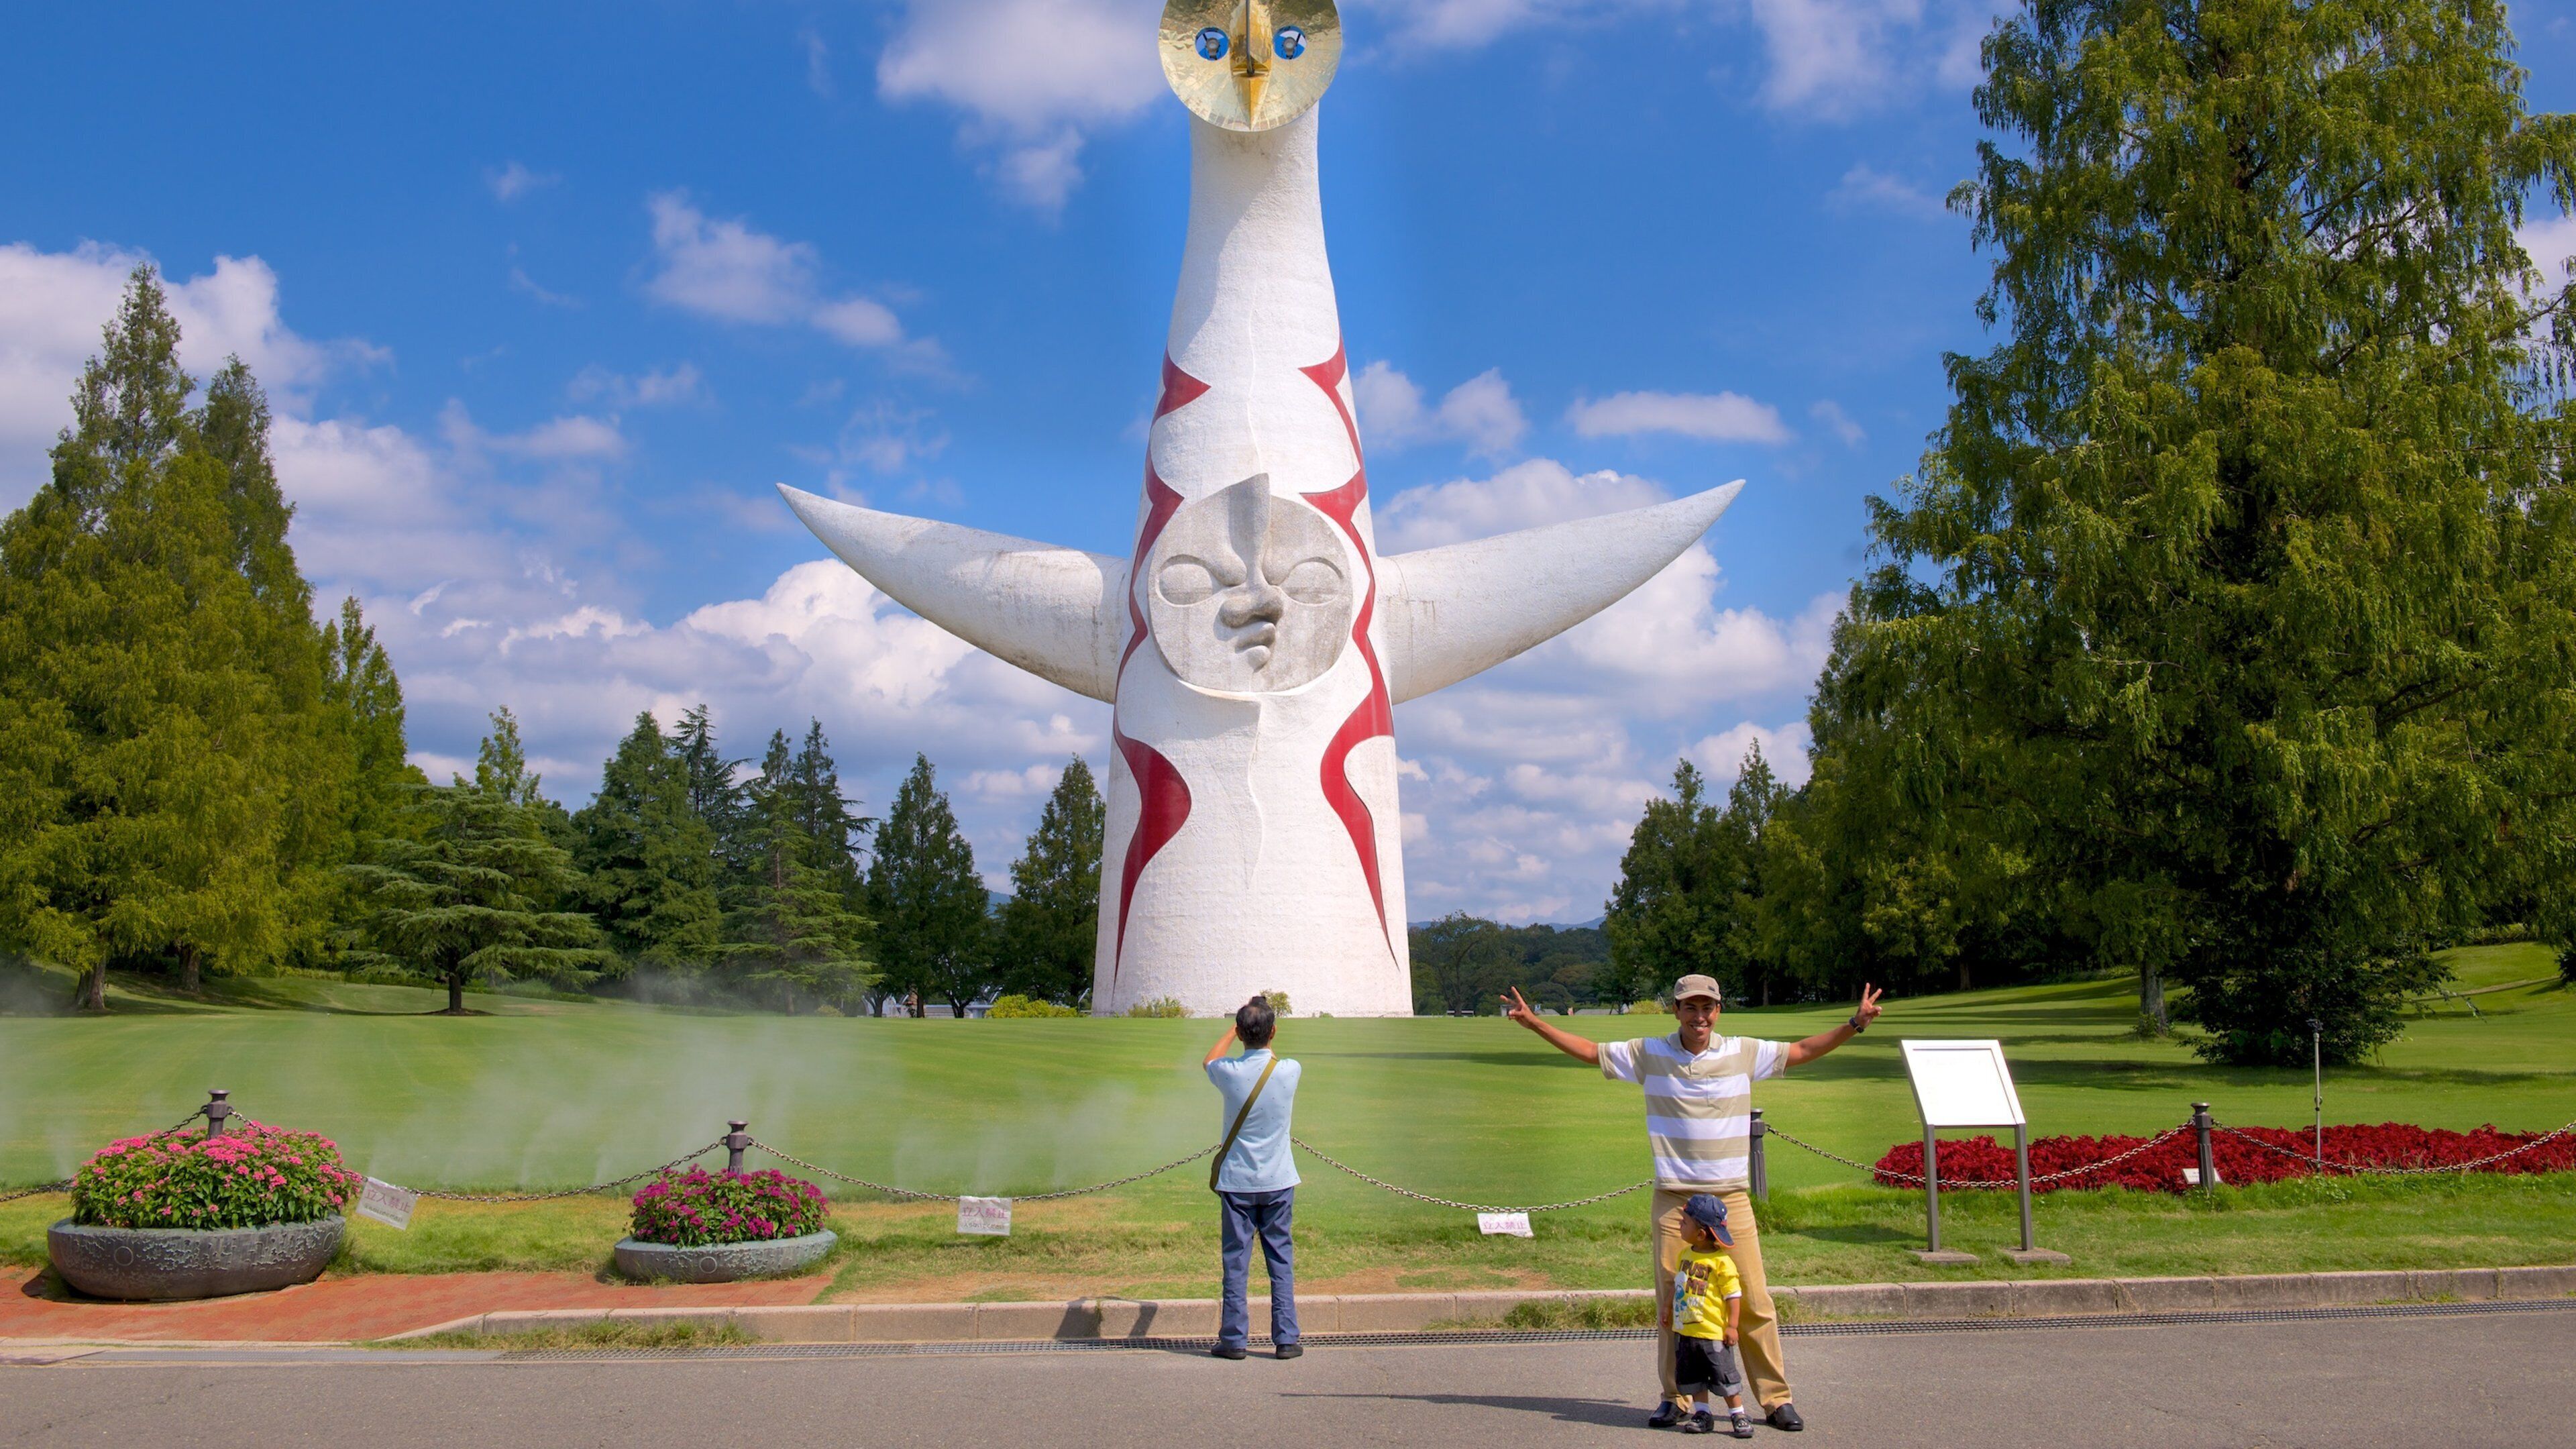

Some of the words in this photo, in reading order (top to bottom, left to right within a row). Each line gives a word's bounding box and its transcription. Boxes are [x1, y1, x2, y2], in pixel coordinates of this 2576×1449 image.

[364, 1189, 411, 1214] 立入禁止
[962, 1207, 1008, 1219] 立入禁止
[1483, 1221, 1527, 1230] 立入禁止
